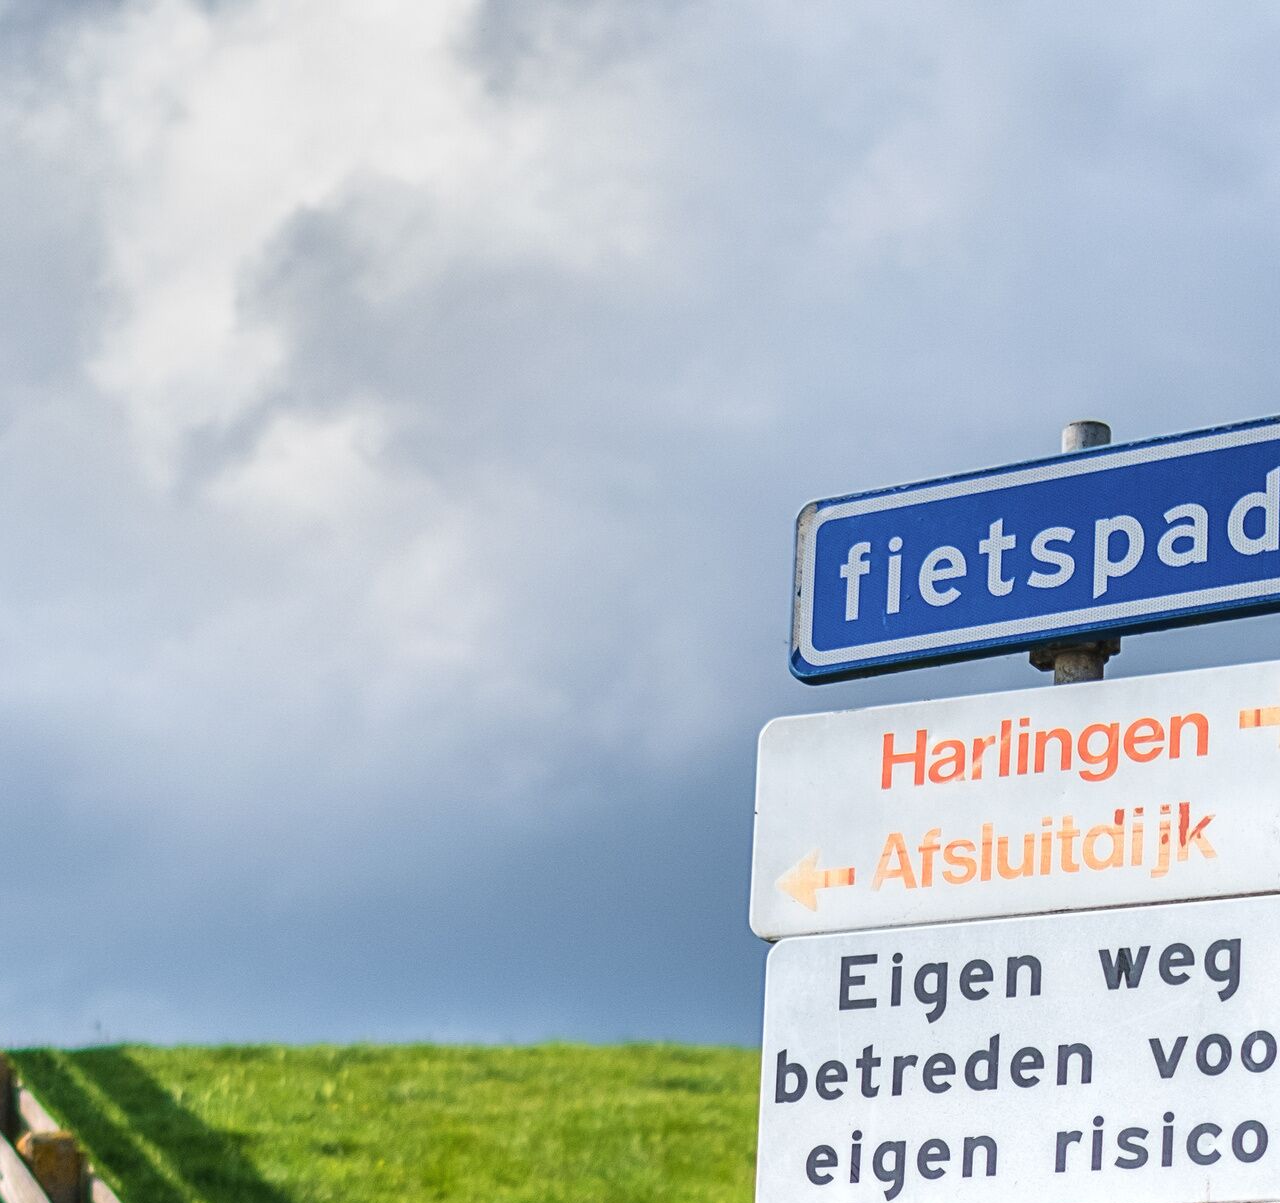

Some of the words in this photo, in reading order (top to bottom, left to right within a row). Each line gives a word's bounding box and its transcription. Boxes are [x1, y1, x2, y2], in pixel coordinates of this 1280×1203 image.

[881, 711, 1209, 789] Harlingen
[871, 801, 1217, 891] Afsluitdijk
[839, 952, 1041, 1023] Eigen
[1098, 937, 1242, 1001] weg
[775, 1033, 1093, 1103] betreden
[806, 1129, 998, 1200] eigen
[1054, 1111, 1269, 1173] risico
